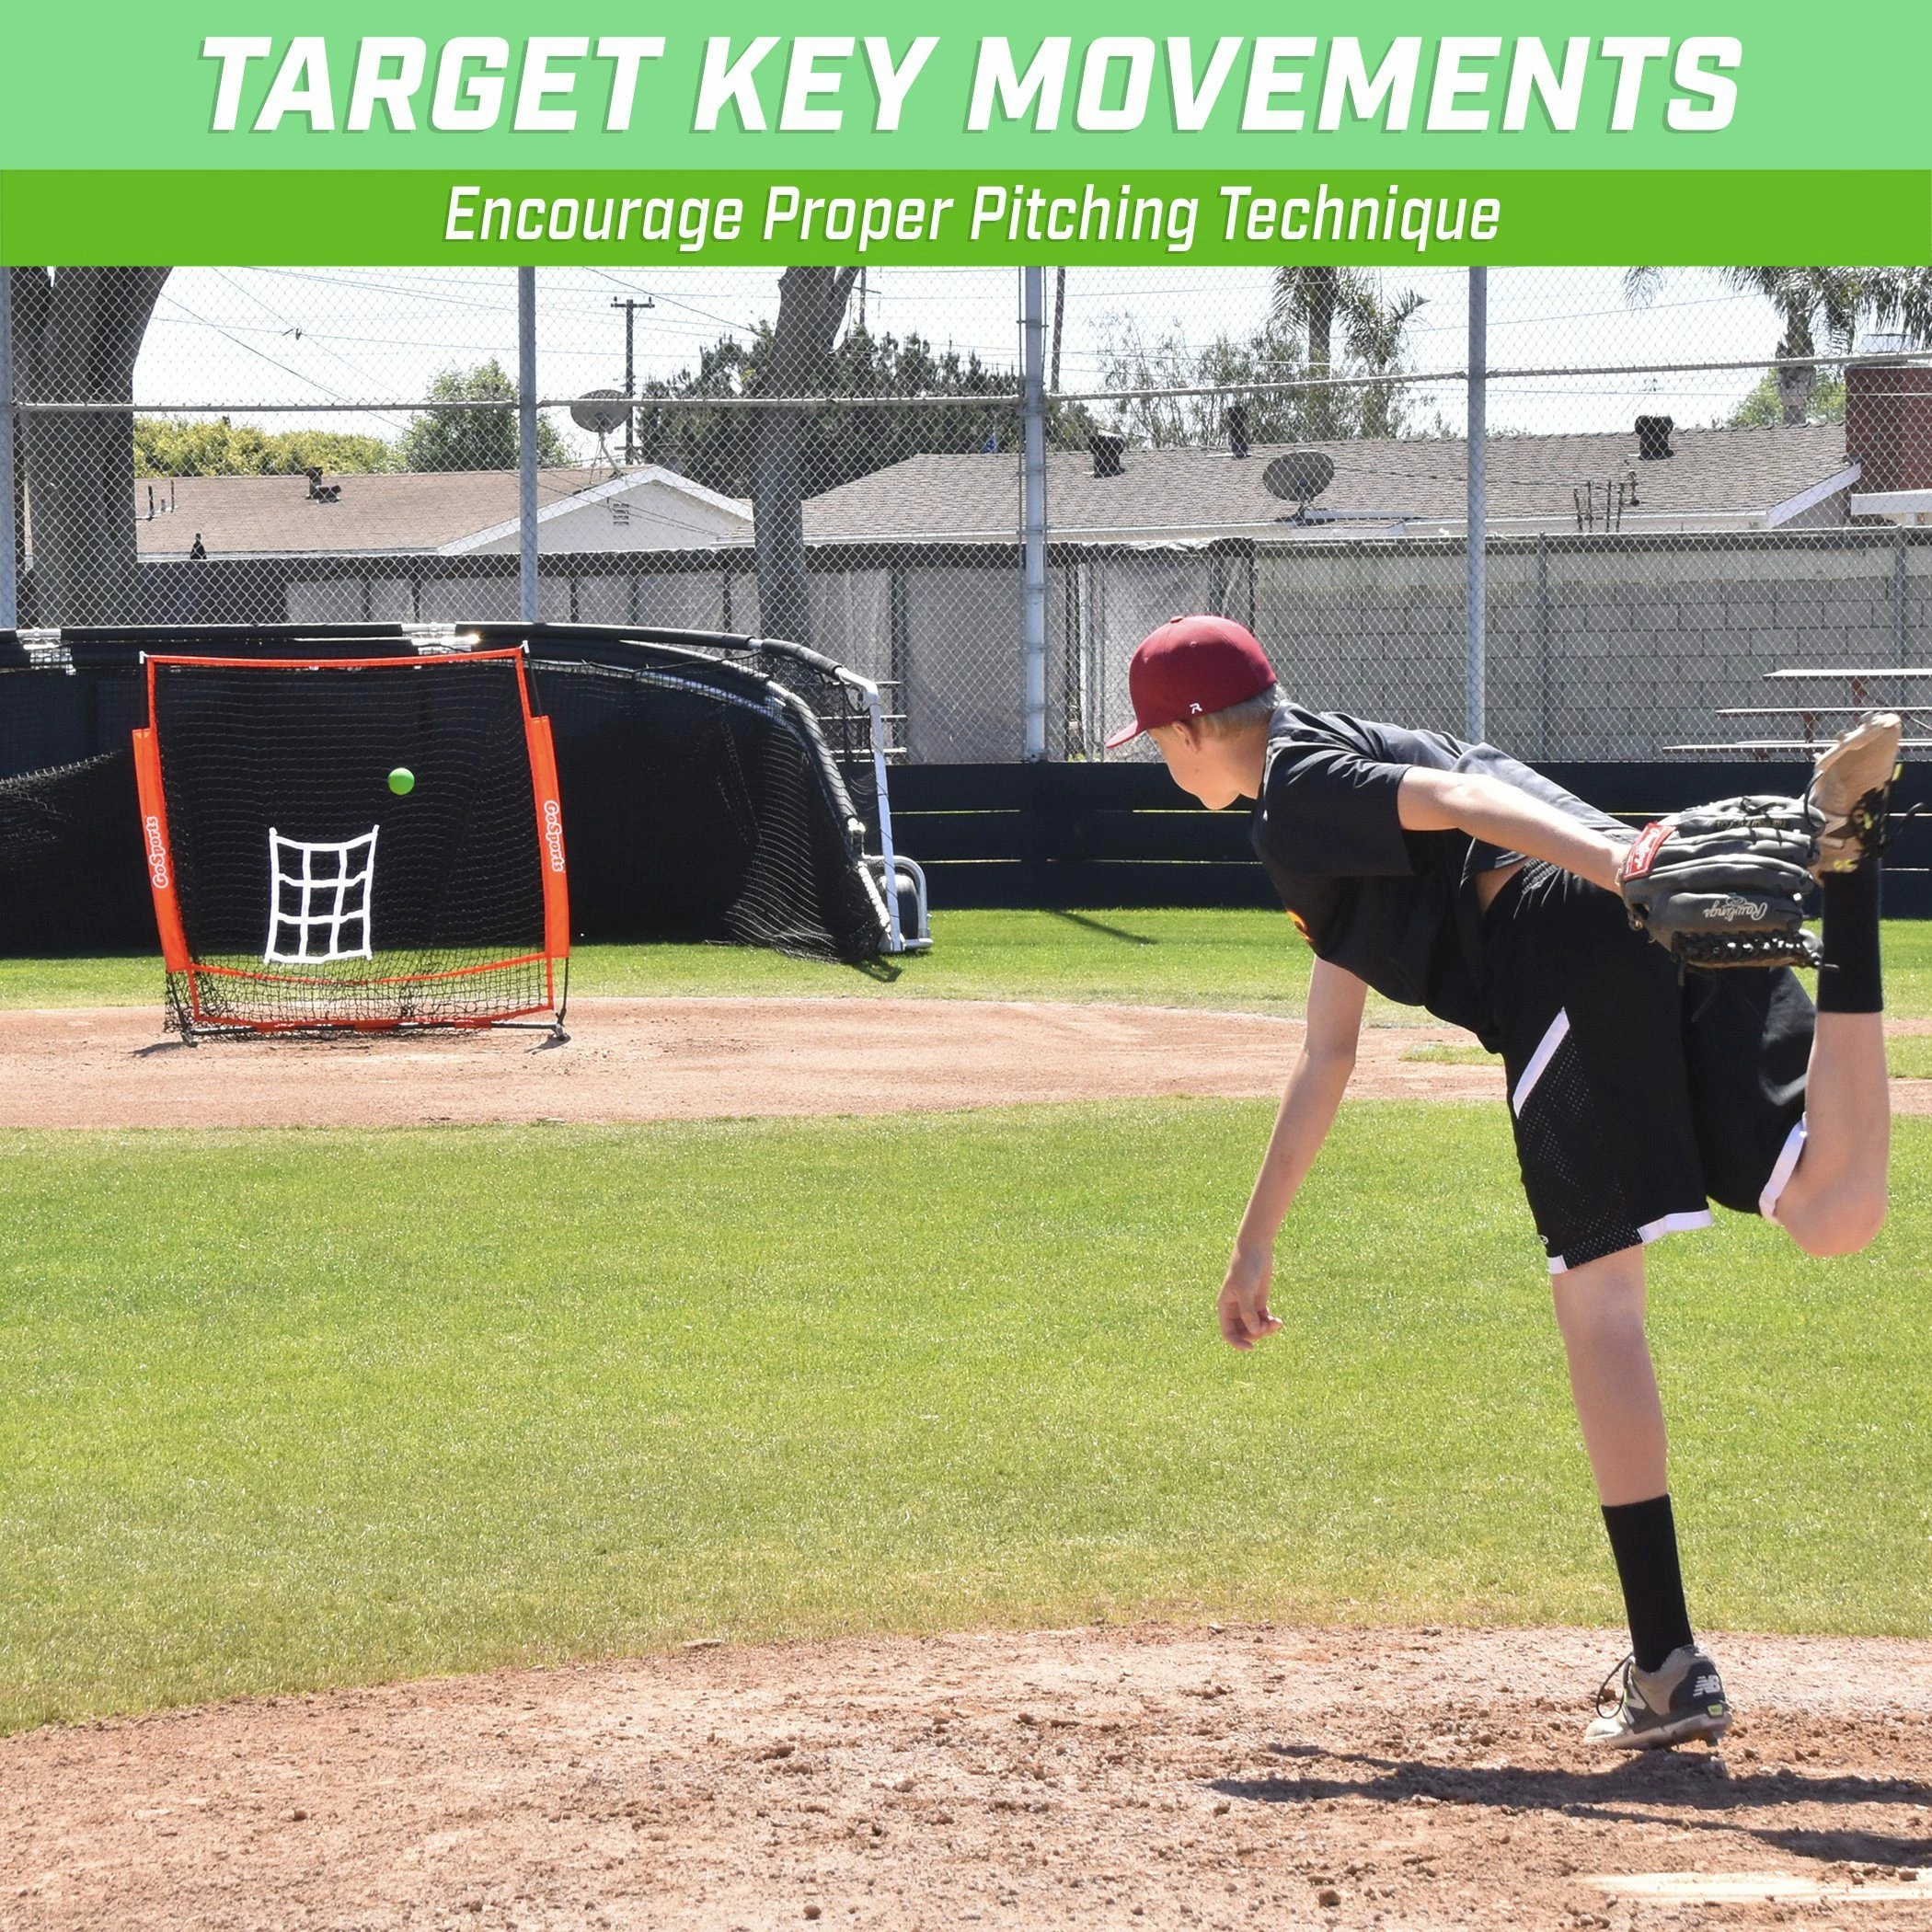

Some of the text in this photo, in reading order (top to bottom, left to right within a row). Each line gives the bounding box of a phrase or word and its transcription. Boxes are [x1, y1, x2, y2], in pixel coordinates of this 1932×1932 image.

[146, 815, 169, 889] GoSports
[543, 799, 565, 872] GoSports
[1702, 900, 1768, 922] Rawlings
